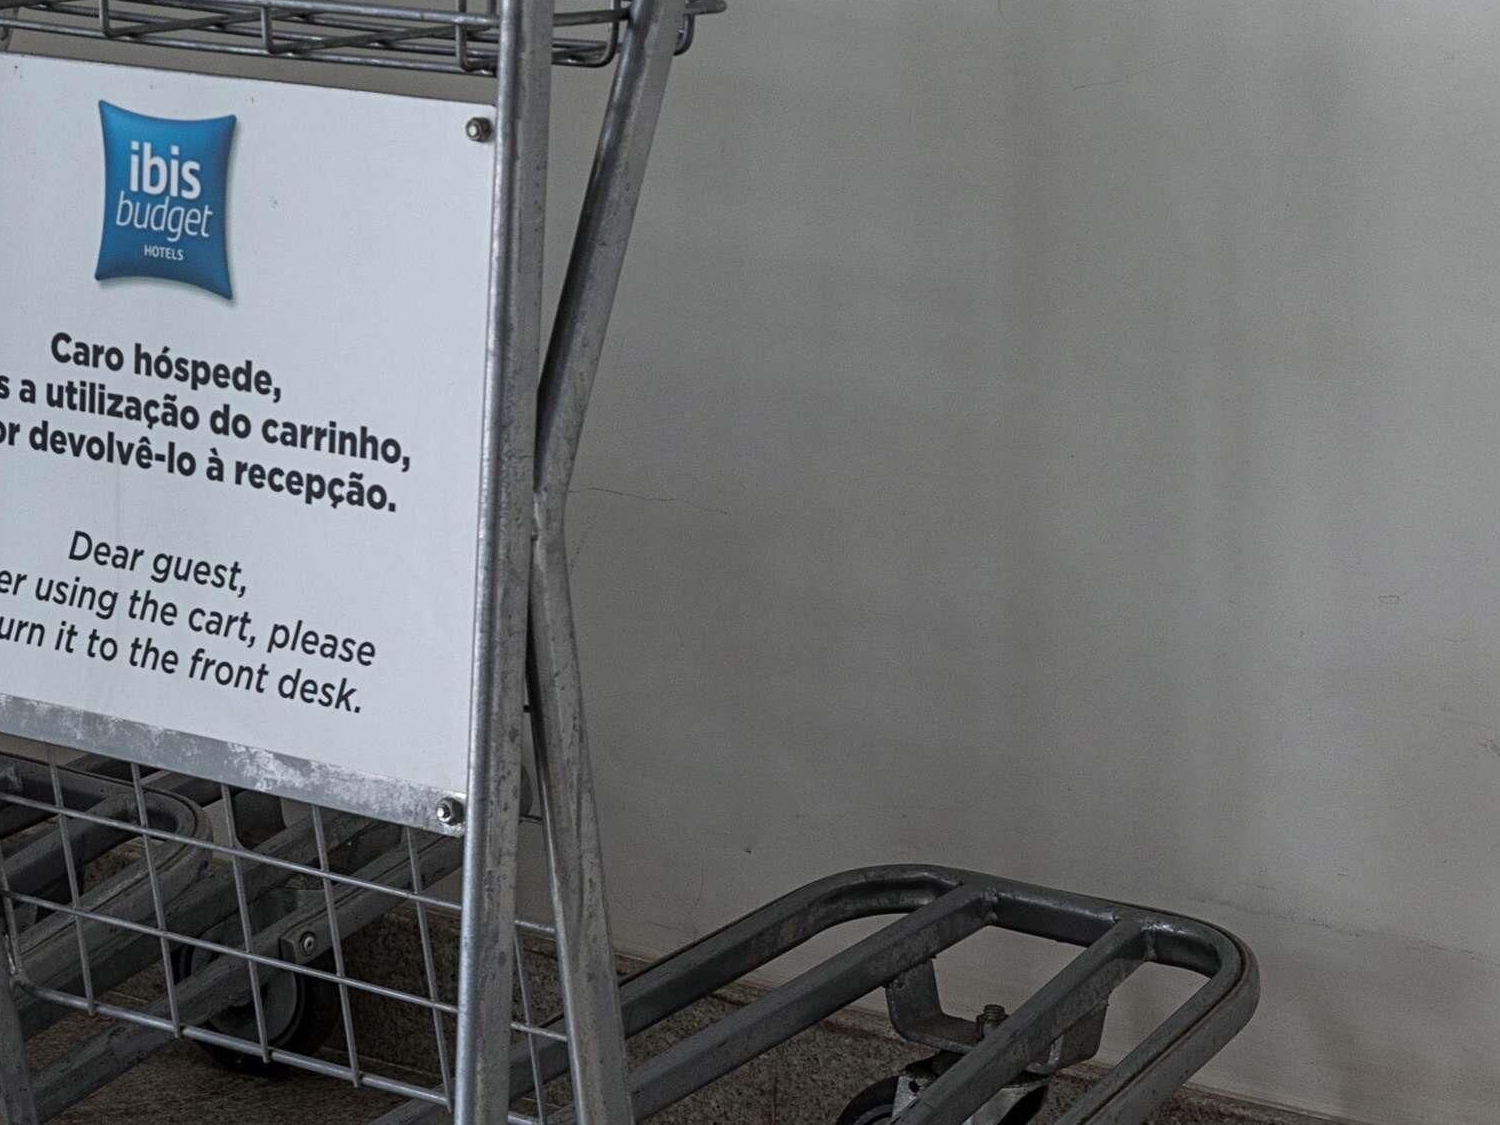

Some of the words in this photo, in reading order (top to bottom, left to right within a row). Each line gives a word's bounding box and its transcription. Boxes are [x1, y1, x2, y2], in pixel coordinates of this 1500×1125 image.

[130, 140, 201, 200] ibis
[115, 189, 213, 243] budget
[144, 245, 184, 260] HOTELS
[51, 332, 124, 372] Caro
[134, 342, 281, 403] hóspede,
[19, 379, 36, 404] a
[46, 380, 200, 431] utilização
[209, 403, 252, 439] do
[261, 418, 410, 473] carrinho,
[29, 420, 197, 477] devolvê-lo
[206, 447, 224, 482] à
[235, 460, 396, 512] recepção.
[68, 530, 145, 571] Dear
[150, 553, 246, 598] guest,
[35, 576, 119, 620] using
[128, 589, 178, 626] the
[188, 607, 256, 648] cart,
[266, 620, 376, 666] please
[55, 620, 80, 656] it
[87, 628, 118, 664] to
[129, 637, 179, 676] the
[188, 648, 270, 693] front
[278, 668, 361, 713] desk.
